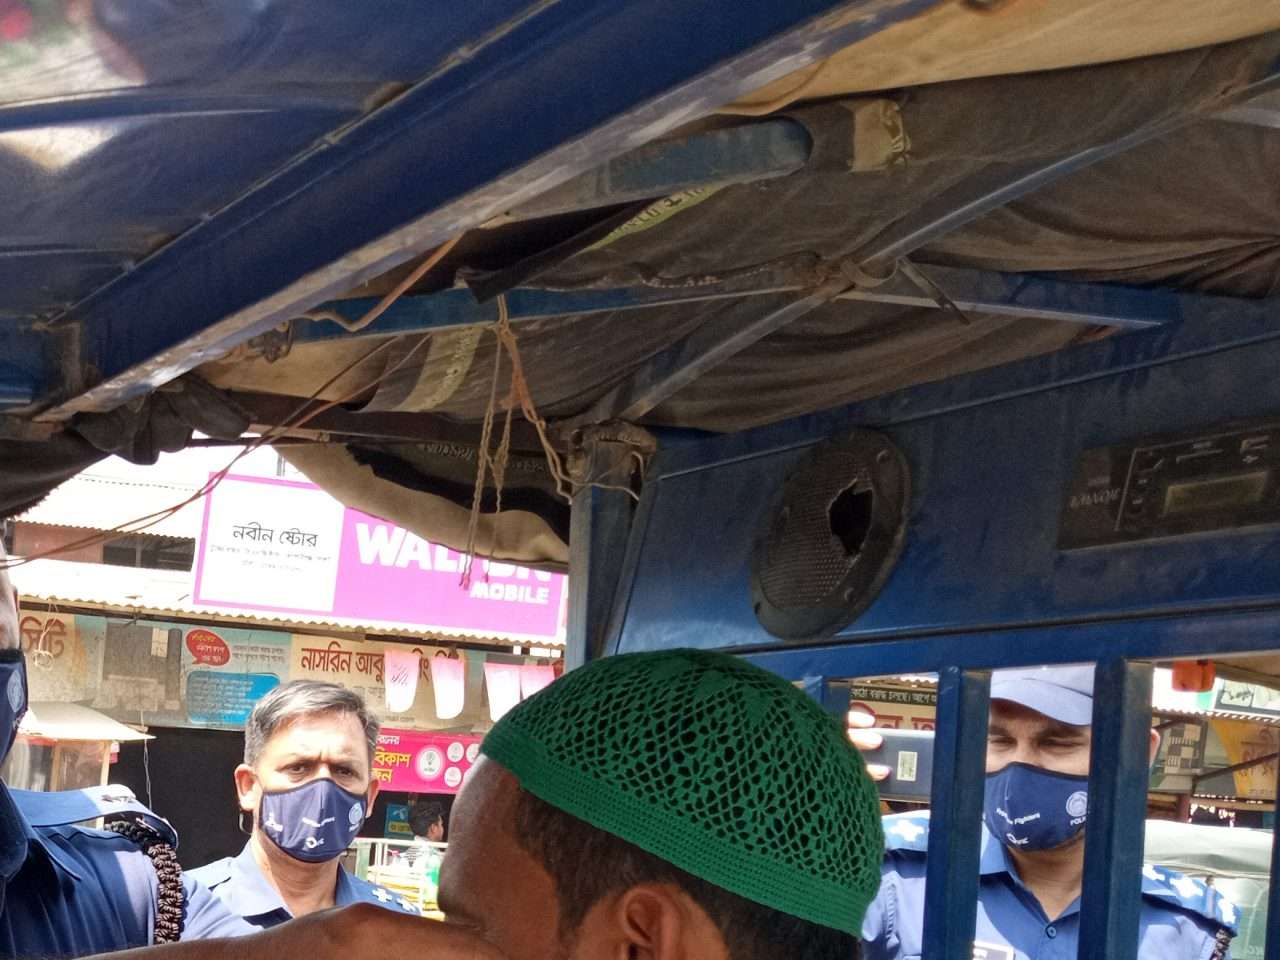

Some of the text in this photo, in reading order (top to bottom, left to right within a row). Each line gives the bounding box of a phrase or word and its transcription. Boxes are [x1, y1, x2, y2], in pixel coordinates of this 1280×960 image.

[232, 521, 274, 543] নবীন
[469, 580, 550, 605] MOBILE
[301, 641, 352, 673] নাসরিন
[356, 650, 385, 682] আবু
